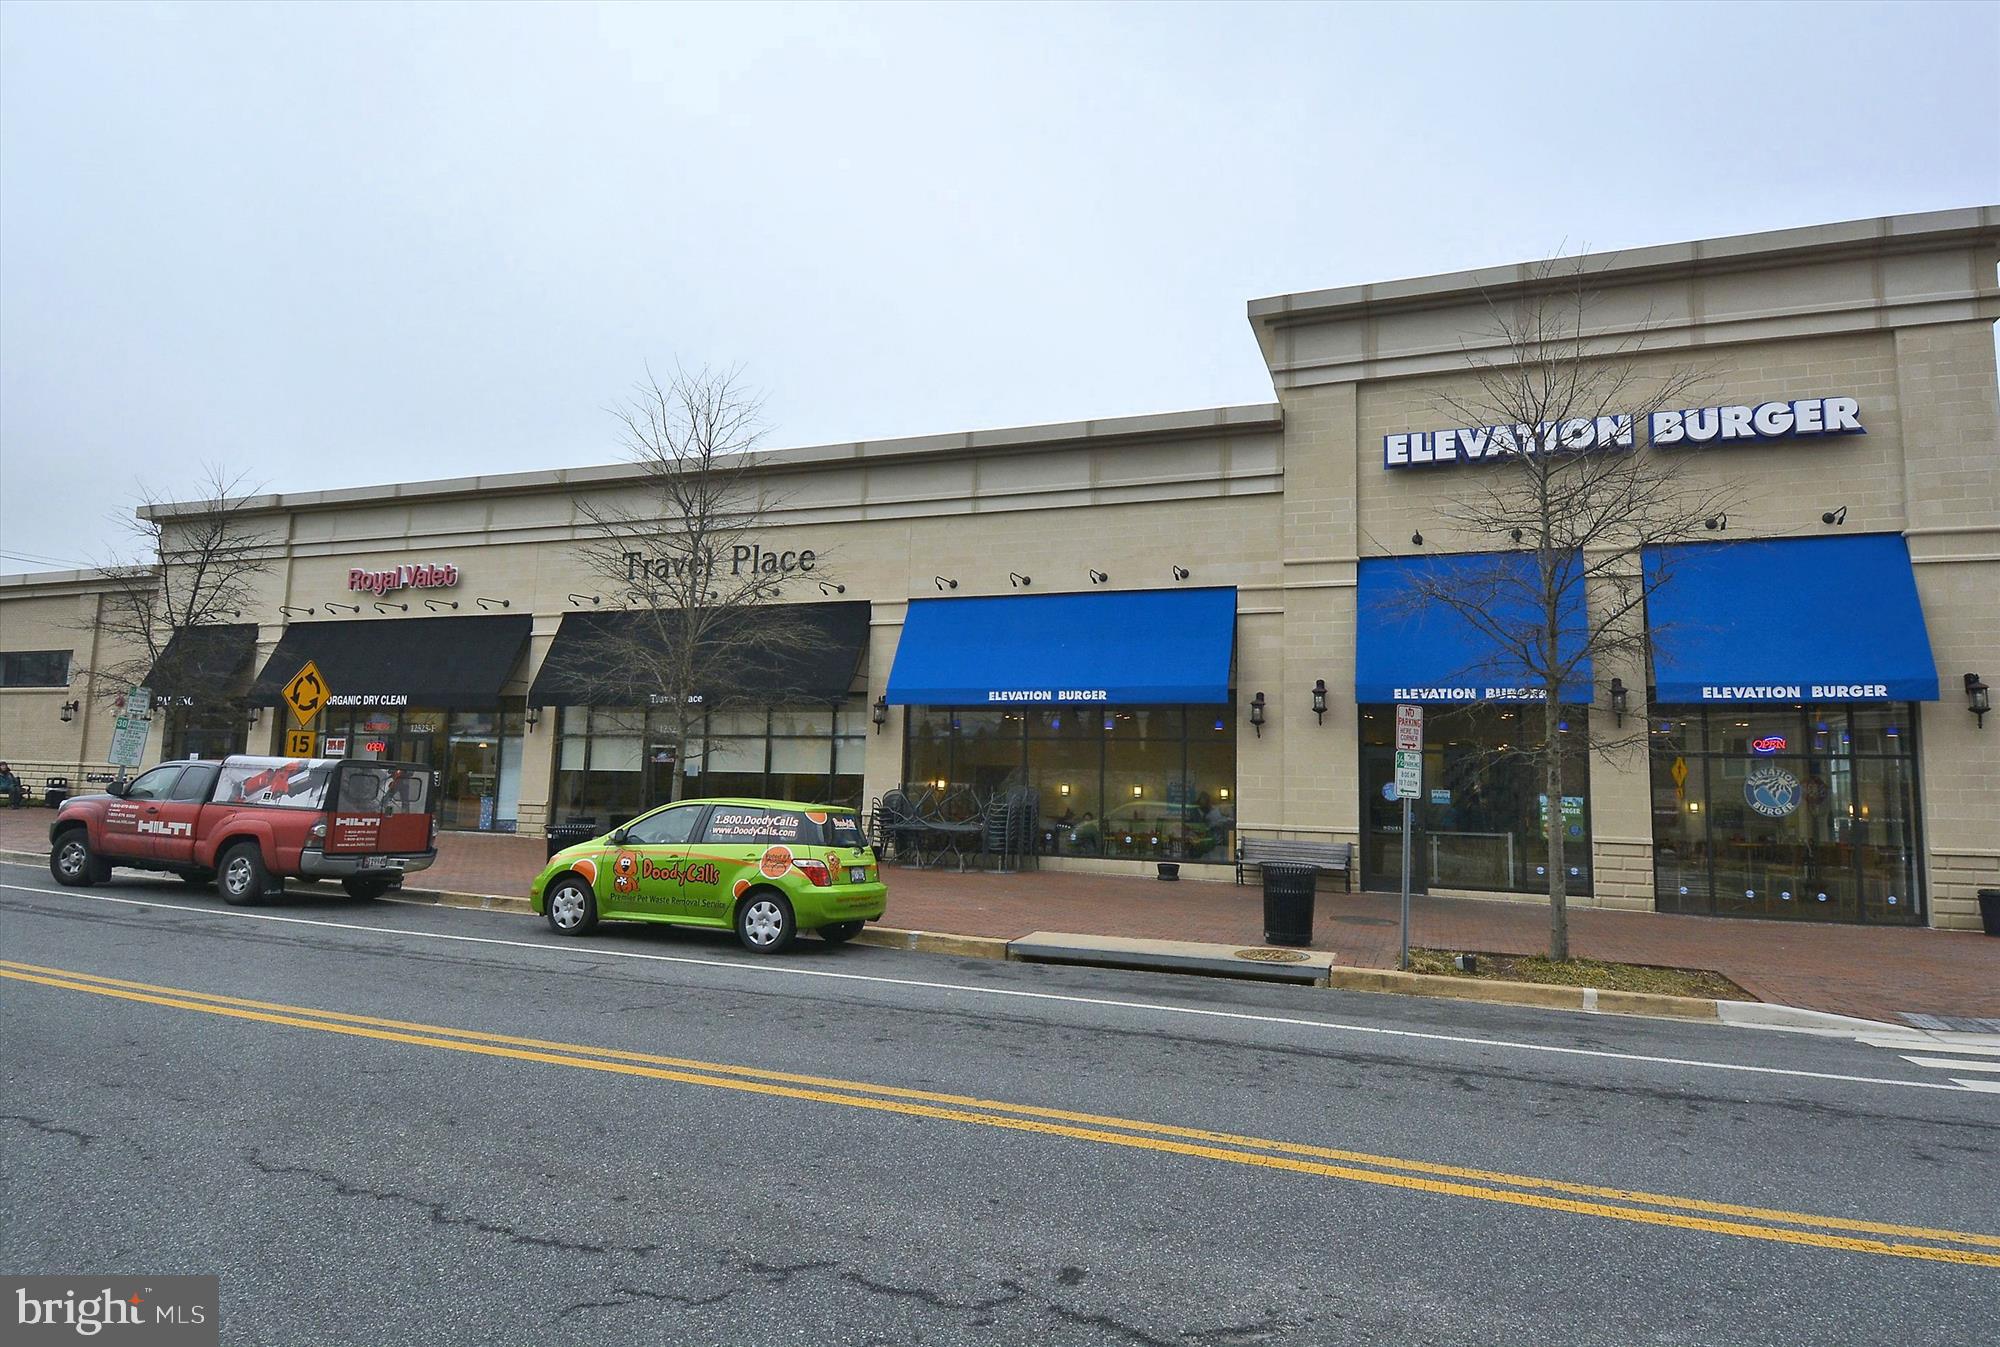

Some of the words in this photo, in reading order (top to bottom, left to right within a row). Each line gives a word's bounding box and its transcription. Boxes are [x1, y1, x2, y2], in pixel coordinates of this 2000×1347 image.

[1385, 414, 1635, 468] ELEVATION
[1652, 397, 1864, 446] BURGER
[622, 547, 714, 580] Travel
[731, 544, 816, 575] Place
[349, 565, 403, 597] Royal
[406, 563, 459, 589] Valet
[988, 691, 1052, 701] ELEVATION
[1058, 690, 1107, 700] BURGER
[1393, 688, 1477, 699] ELEVATION
[1485, 687, 1548, 699] BURGER
[1702, 686, 1801, 699] ELEVATION
[1811, 684, 1888, 698] BURGER
[326, 695, 362, 706] ORGANIC
[363, 695, 380, 705] DRY
[380, 695, 408, 706] CLEAN
[1405, 708, 1415, 718] NO
[117, 719, 128, 728] 30
[1398, 717, 1421, 728] PARKING
[292, 735, 310, 753] 15
[365, 741, 386, 753] OPEN
[1752, 739, 1787, 749] OPEN
[1747, 768, 1798, 788] ELEVATION
[1752, 801, 1795, 816] BURGER
[335, 817, 381, 826] HILTI
[715, 815, 800, 827] 1.800.DoodyCalls
[137, 820, 192, 836] HILTI
[712, 826, 796, 838] www.DoodyCalls.com
[642, 858, 721, 886] DoodyCalls
[610, 892, 636, 902] Premier
[649, 895, 670, 905] Waste
[671, 896, 700, 906] Removal
[700, 898, 726, 909] Service
